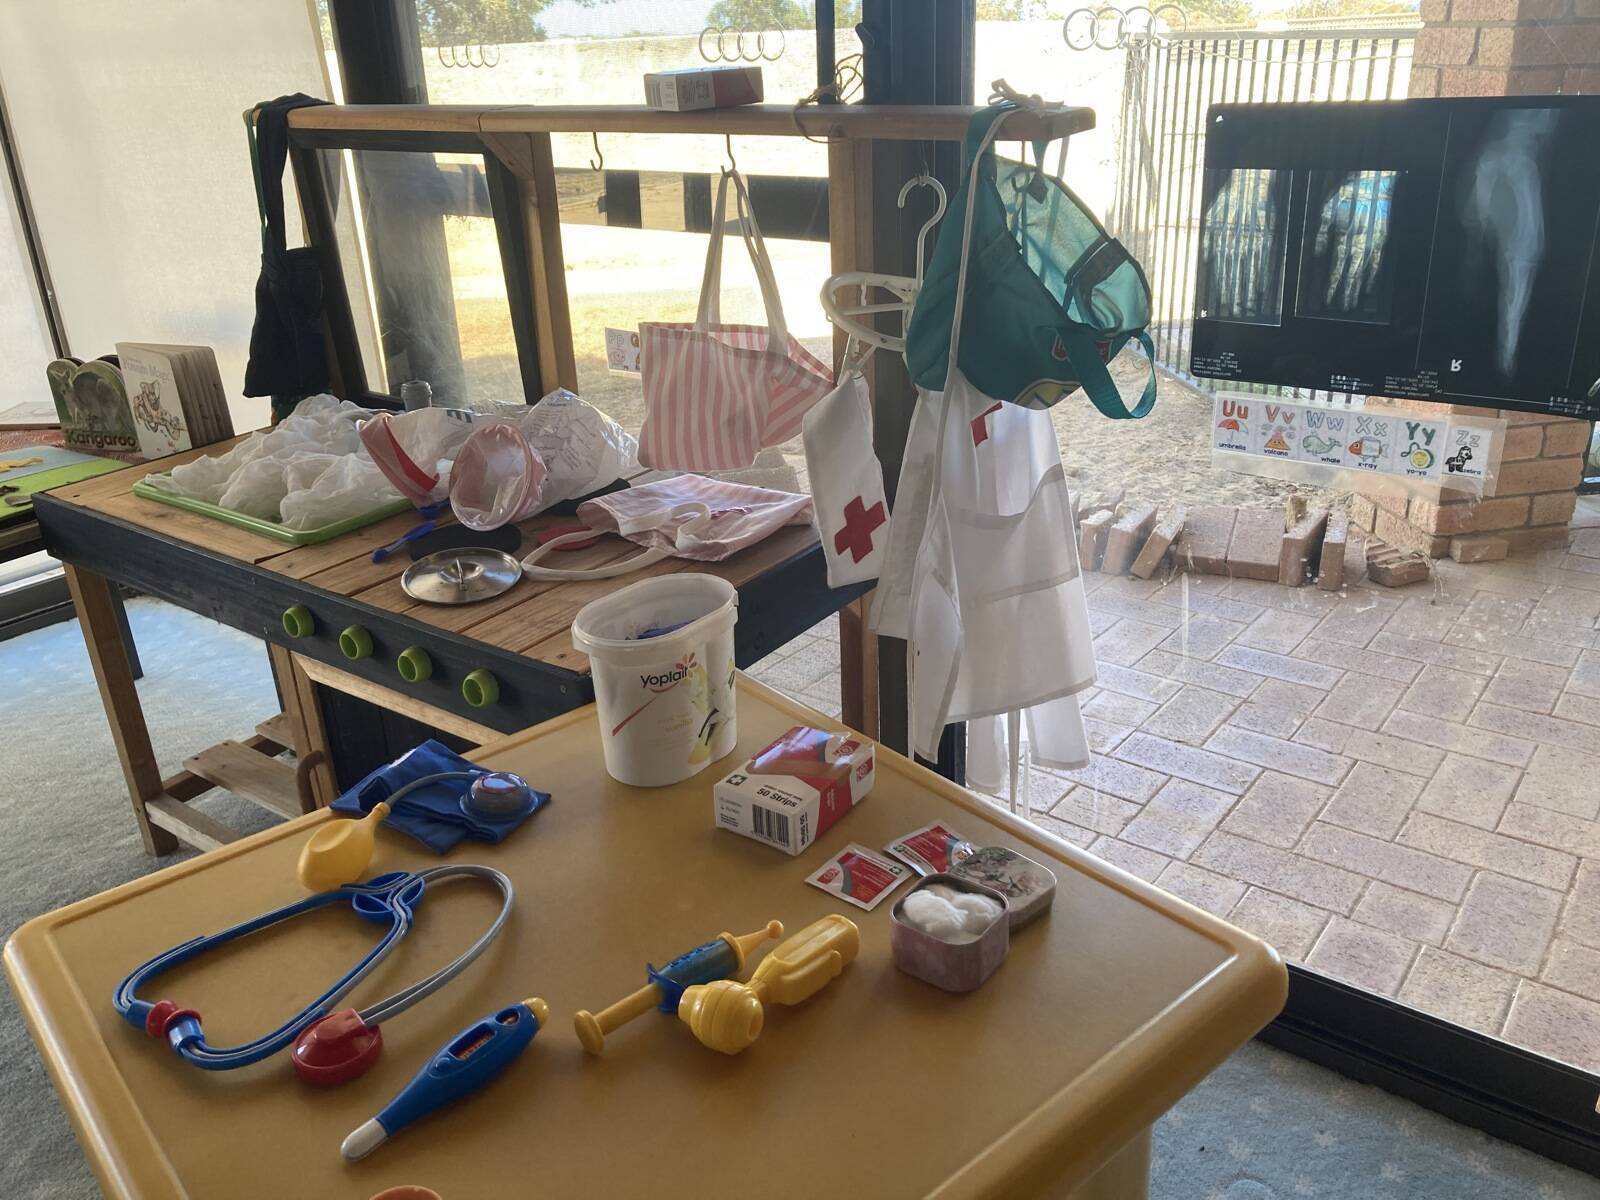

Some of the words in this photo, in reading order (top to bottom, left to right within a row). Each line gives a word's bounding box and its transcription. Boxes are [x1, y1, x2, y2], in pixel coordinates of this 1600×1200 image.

[1222, 399, 1249, 420] Uu
[1265, 405, 1296, 424] Vv
[1306, 410, 1344, 431] Ww
[1356, 416, 1388, 437] Xx
[1406, 421, 1436, 446] Yy
[1456, 430, 1481, 448] Zz
[67, 430, 136, 448] Kangaroo
[1263, 449, 1289, 457] volcano
[1357, 462, 1378, 470] x-ray
[1406, 468, 1427, 476] yo-yo
[757, 787, 771, 797] 50
[770, 792, 798, 808] Strips
